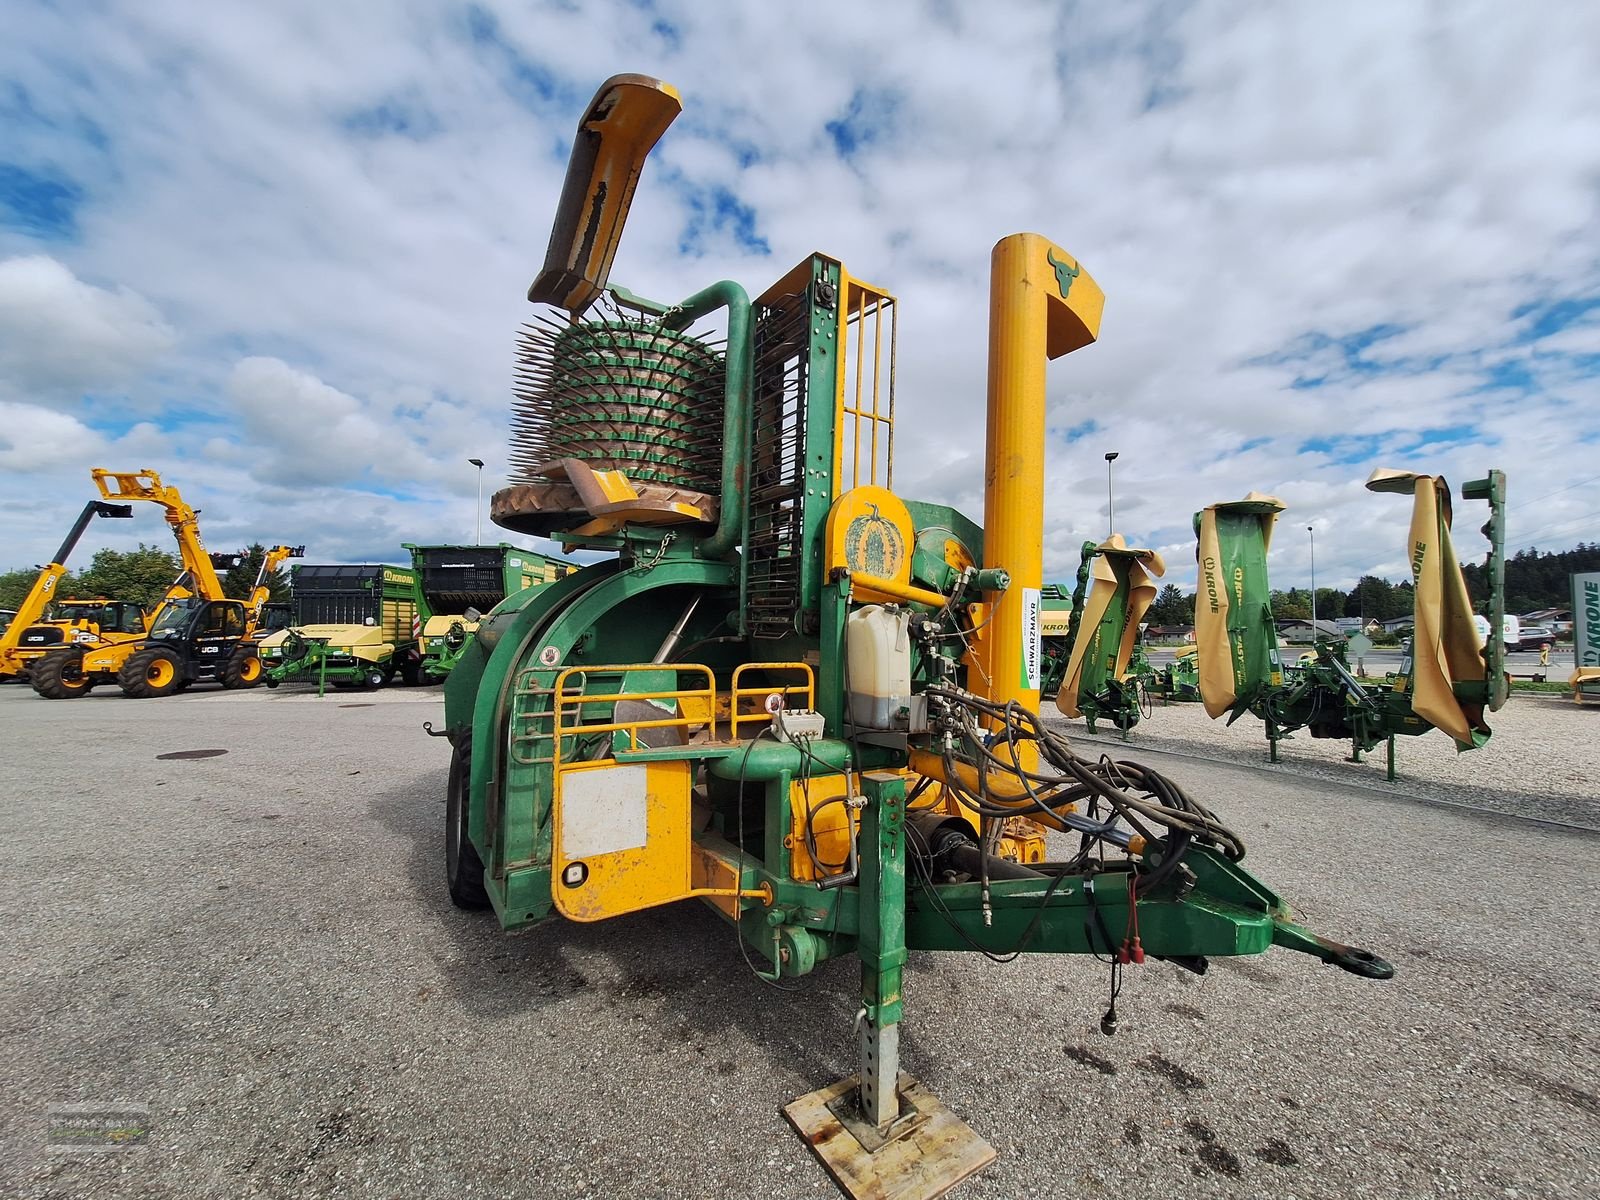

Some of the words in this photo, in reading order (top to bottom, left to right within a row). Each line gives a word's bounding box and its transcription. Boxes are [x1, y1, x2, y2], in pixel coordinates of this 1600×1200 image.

[42, 575, 56, 593] JCB
[1205, 571, 1219, 614] KRONE
[1584, 581, 1600, 649] KRONE
[72, 634, 99, 643] JCB
[1028, 602, 1036, 680] SCHWARZMAYR
